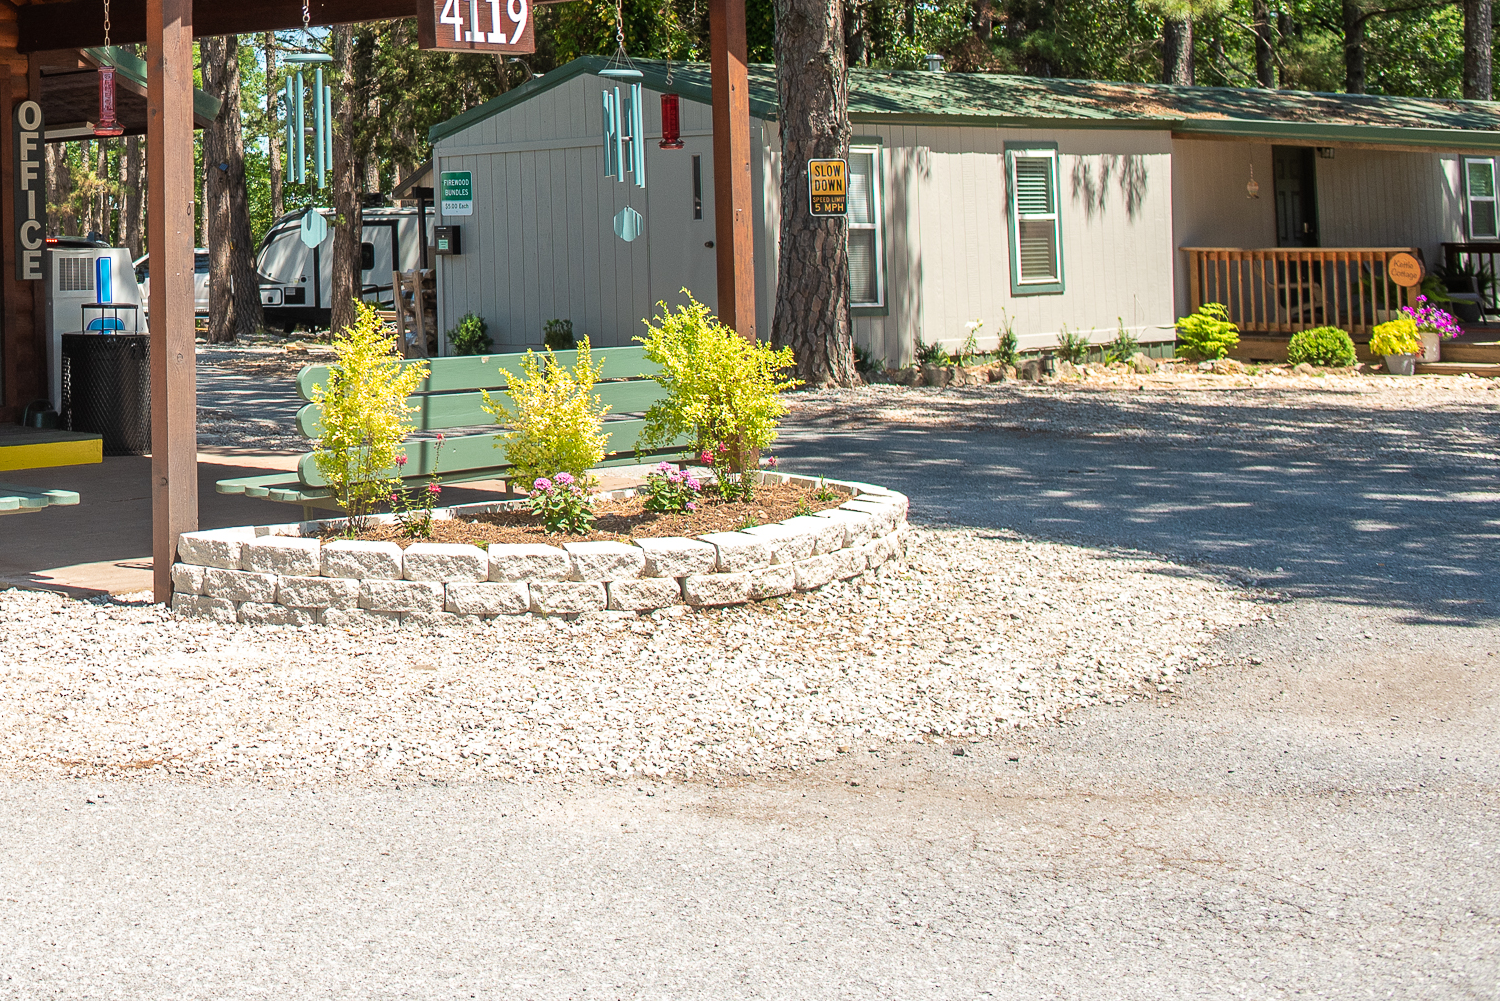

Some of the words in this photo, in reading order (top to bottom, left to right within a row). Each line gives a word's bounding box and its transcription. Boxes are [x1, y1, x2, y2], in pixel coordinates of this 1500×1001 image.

[814, 165, 841, 177] SLOW
[18, 100, 43, 280] OFFICE
[815, 179, 842, 191] DOWN
[815, 203, 821, 212] 5
[824, 203, 844, 212] MPH
[1393, 259, 1414, 269] Kettle
[1391, 268, 1418, 280] Cottage
